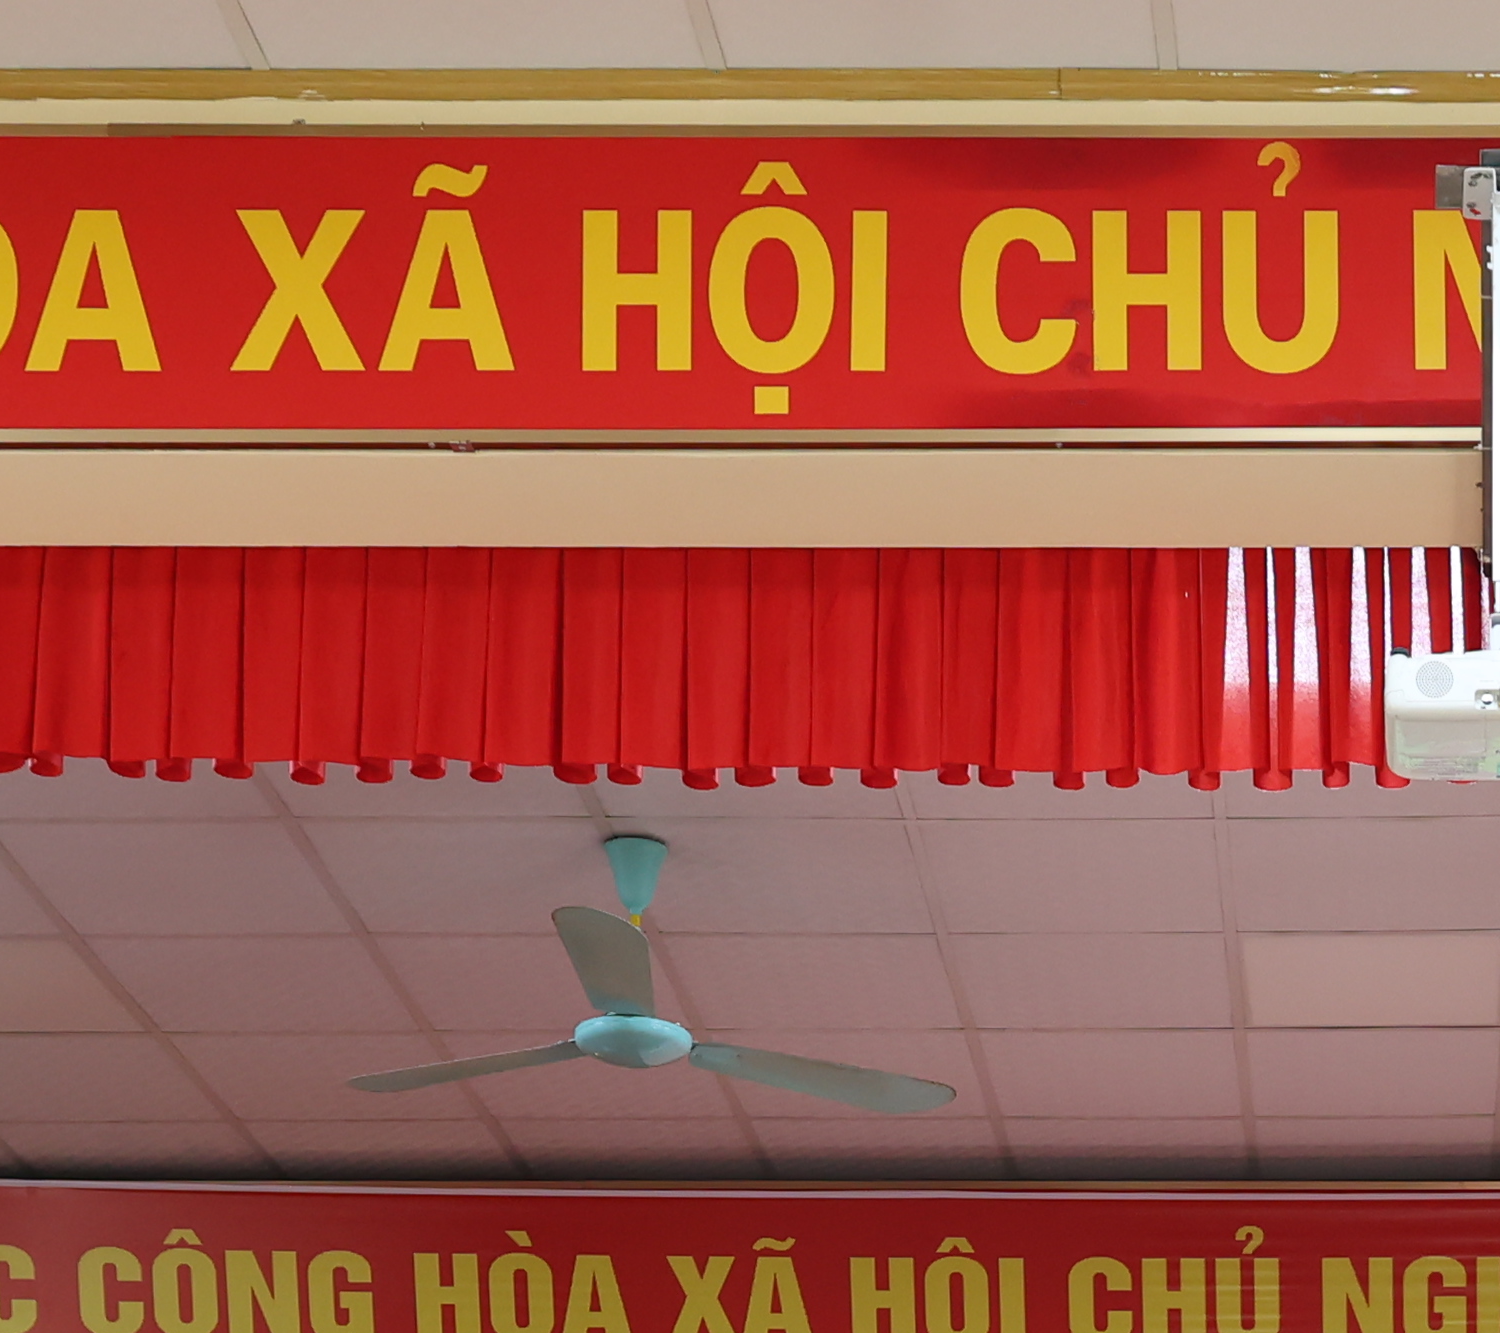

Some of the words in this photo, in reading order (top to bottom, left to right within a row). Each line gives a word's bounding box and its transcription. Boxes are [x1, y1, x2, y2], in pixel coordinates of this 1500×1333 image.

[232, 164, 517, 373] XÃ
[582, 162, 889, 415] HỘI
[961, 143, 1341, 375] CHỦ
